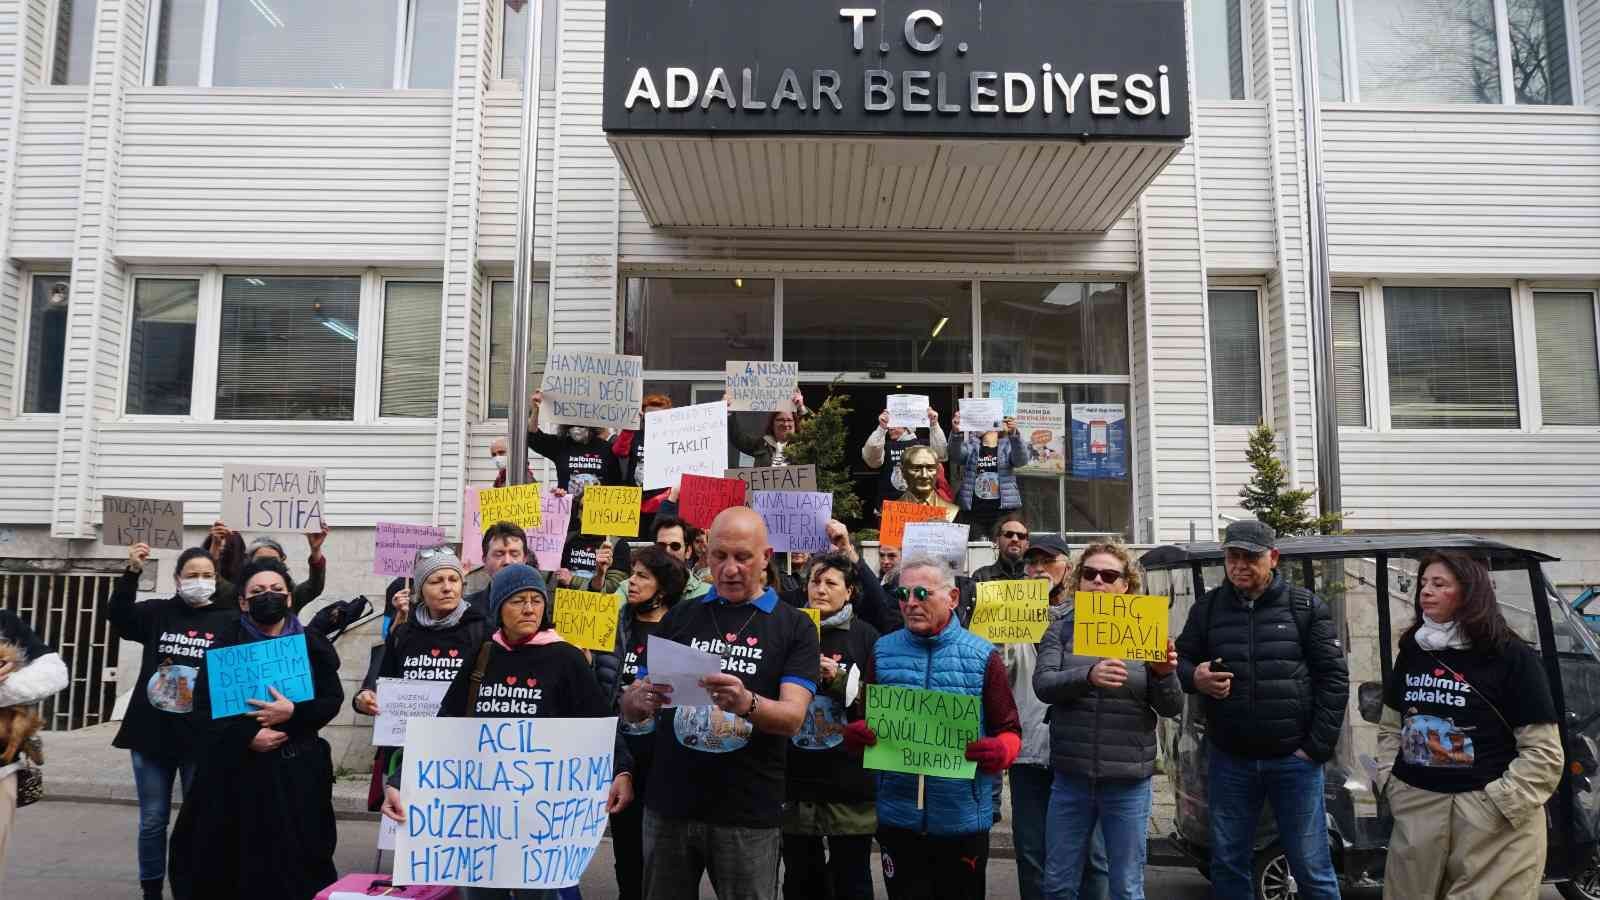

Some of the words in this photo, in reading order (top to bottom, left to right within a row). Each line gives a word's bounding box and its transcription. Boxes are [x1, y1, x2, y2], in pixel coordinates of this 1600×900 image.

[624, 67, 842, 110] ADALAR
[864, 63, 1170, 117] BELEDİYESİ
[230, 472, 301, 494] MUSTAFA
[306, 469, 326, 494] ÜN
[588, 507, 638, 525] UYGULA
[690, 637, 763, 661] kalbimiz
[403, 654, 464, 669] kalbimiz
[478, 683, 542, 700] kalbimiz
[1405, 673, 1472, 693] kalbimiz
[476, 699, 538, 714] sokakta
[1404, 688, 1467, 707] sokakta
[903, 747, 962, 770] BURADA
[418, 753, 614, 796] KISIRLAŞTIRMA
[411, 842, 498, 882] HİZMET
